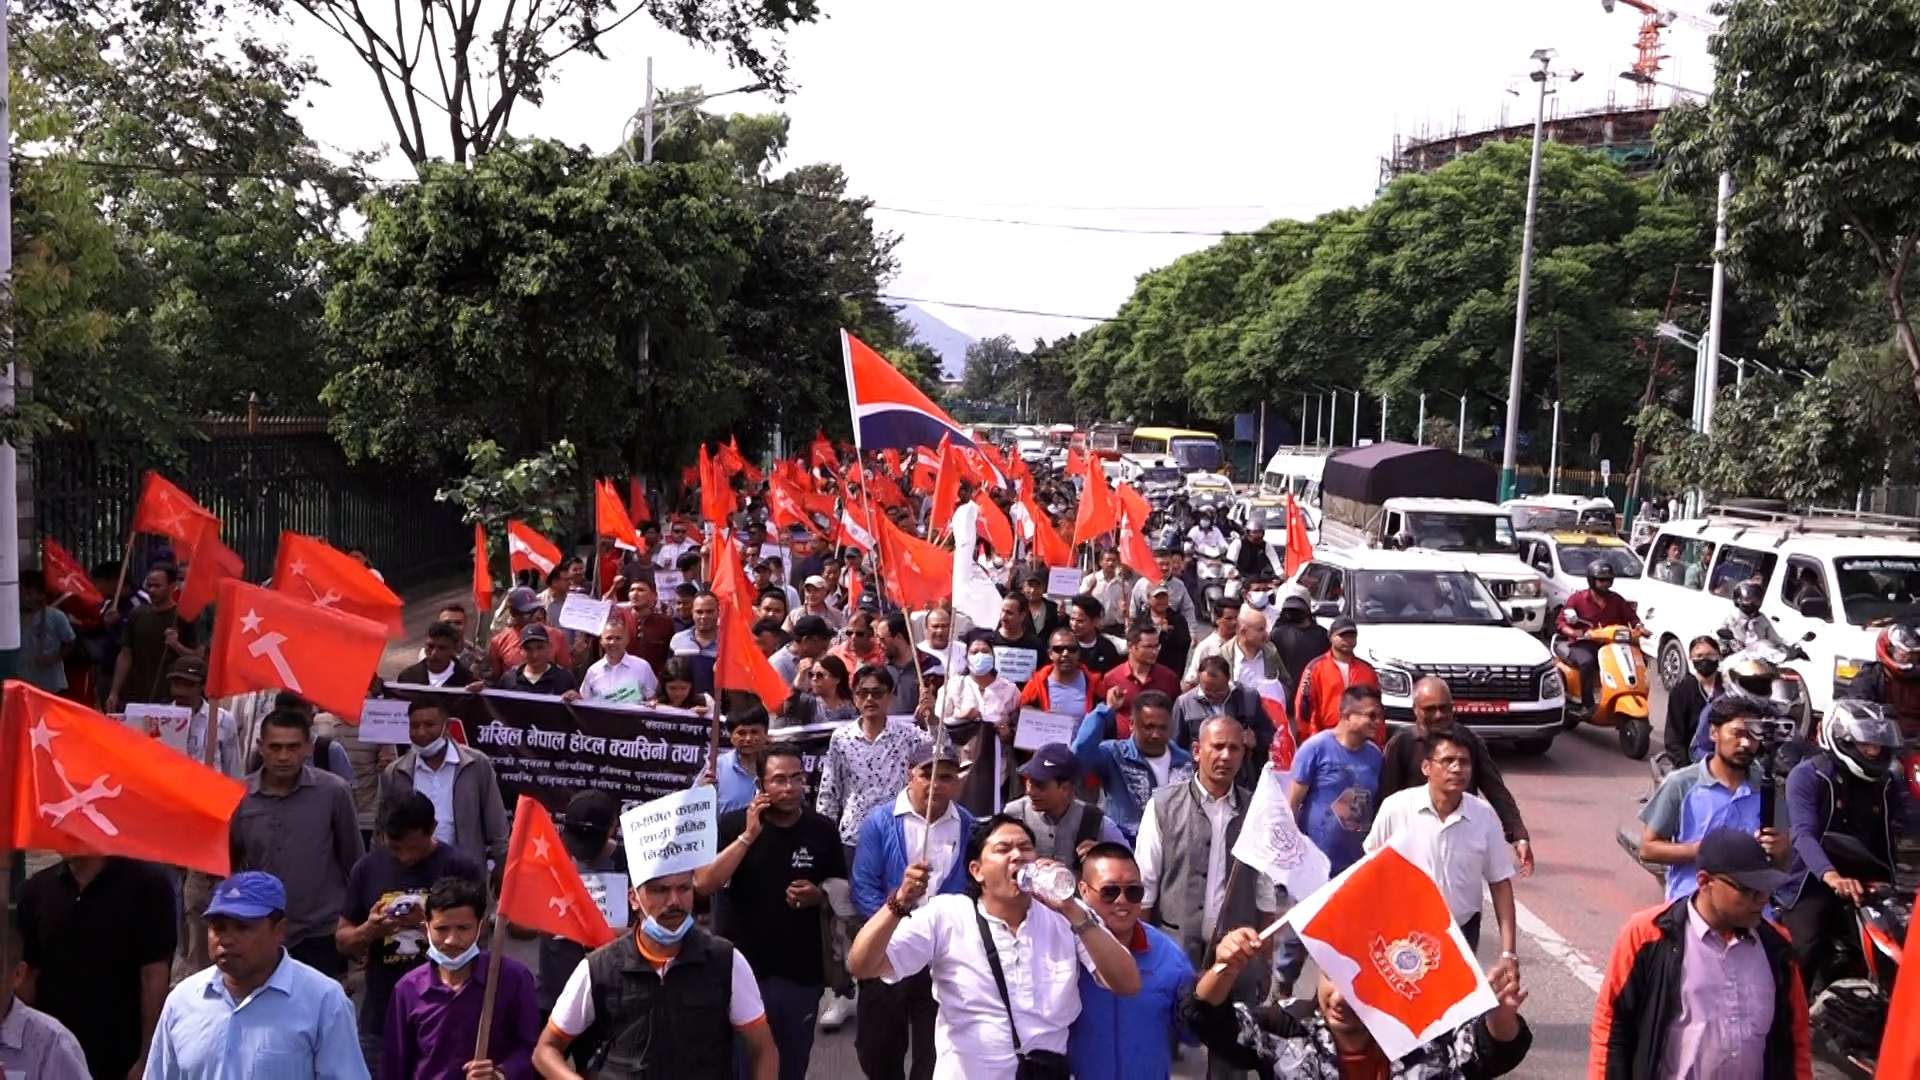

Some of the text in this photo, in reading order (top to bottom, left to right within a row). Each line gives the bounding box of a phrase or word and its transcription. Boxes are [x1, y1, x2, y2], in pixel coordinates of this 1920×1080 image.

[477, 721, 523, 747] अखिल
[569, 729, 605, 755] होटल
[609, 736, 669, 761] क्यासिनो
[672, 746, 699, 764] तथा
